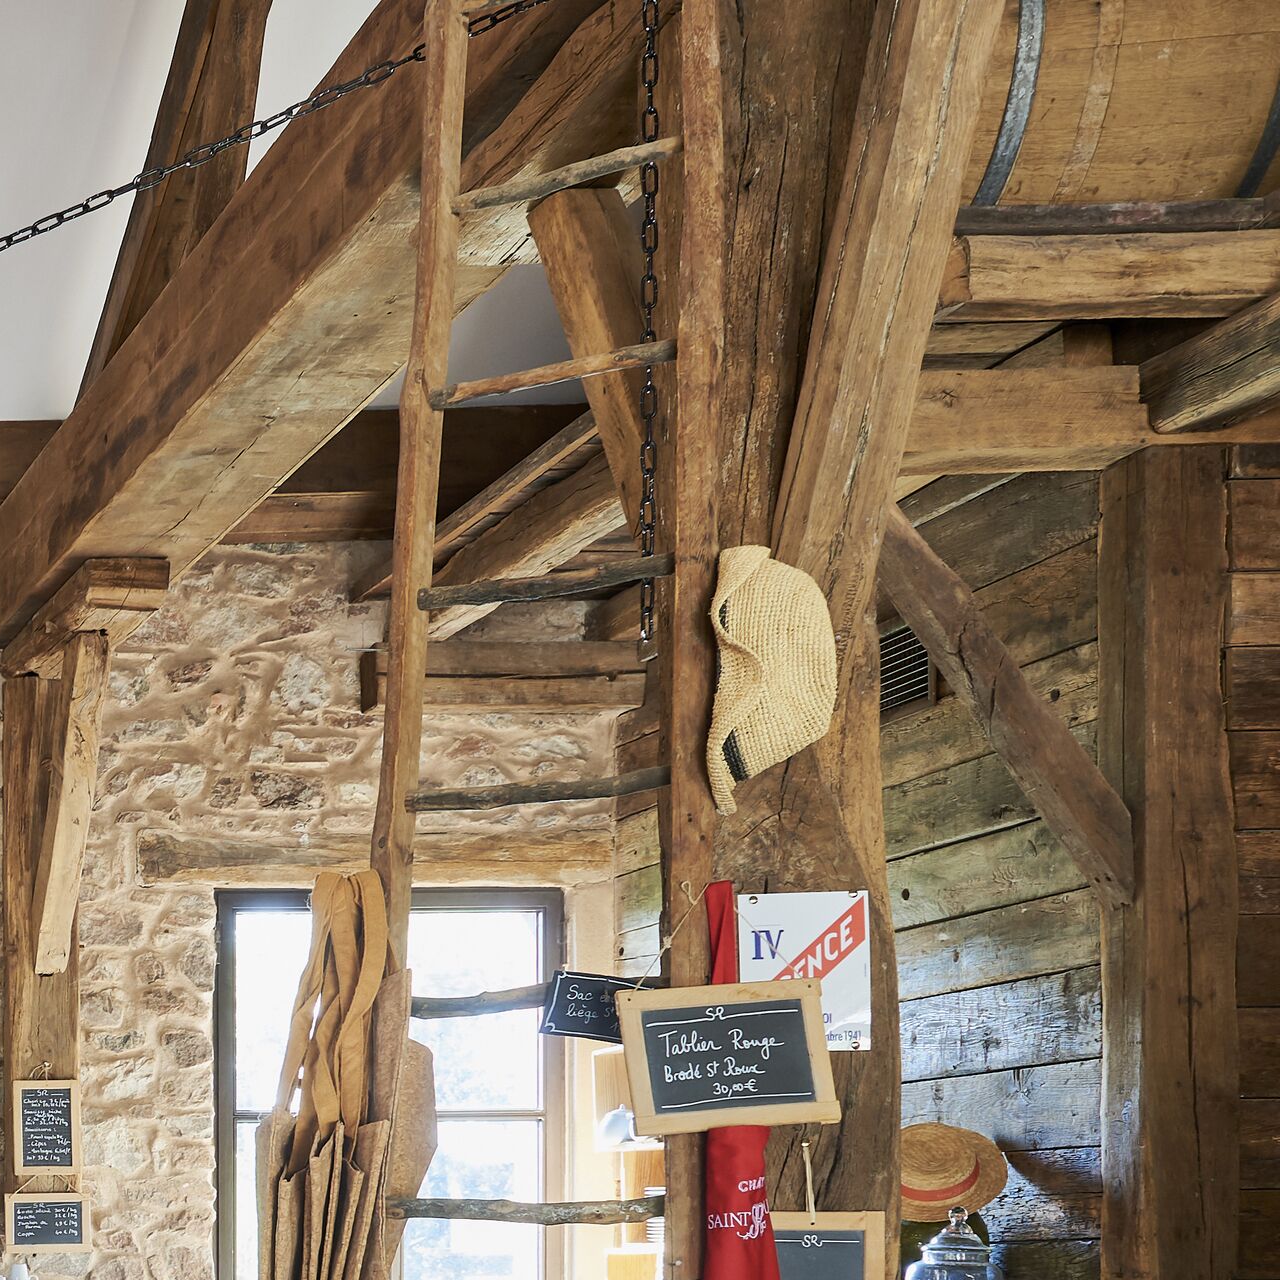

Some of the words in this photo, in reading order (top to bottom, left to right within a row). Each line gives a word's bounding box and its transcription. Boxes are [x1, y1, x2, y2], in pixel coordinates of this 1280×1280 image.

[751, 929, 784, 960] IV
[567, 984, 594, 1000] Sac
[565, 1003, 599, 1024] liège
[658, 1030, 722, 1058] Tablier
[732, 1028, 784, 1059] Rouge
[845, 1030, 861, 1041] 1941
[664, 1063, 703, 1083] Brodé
[724, 1057, 765, 1077] Roux
[708, 1211, 751, 1229] SAINT
